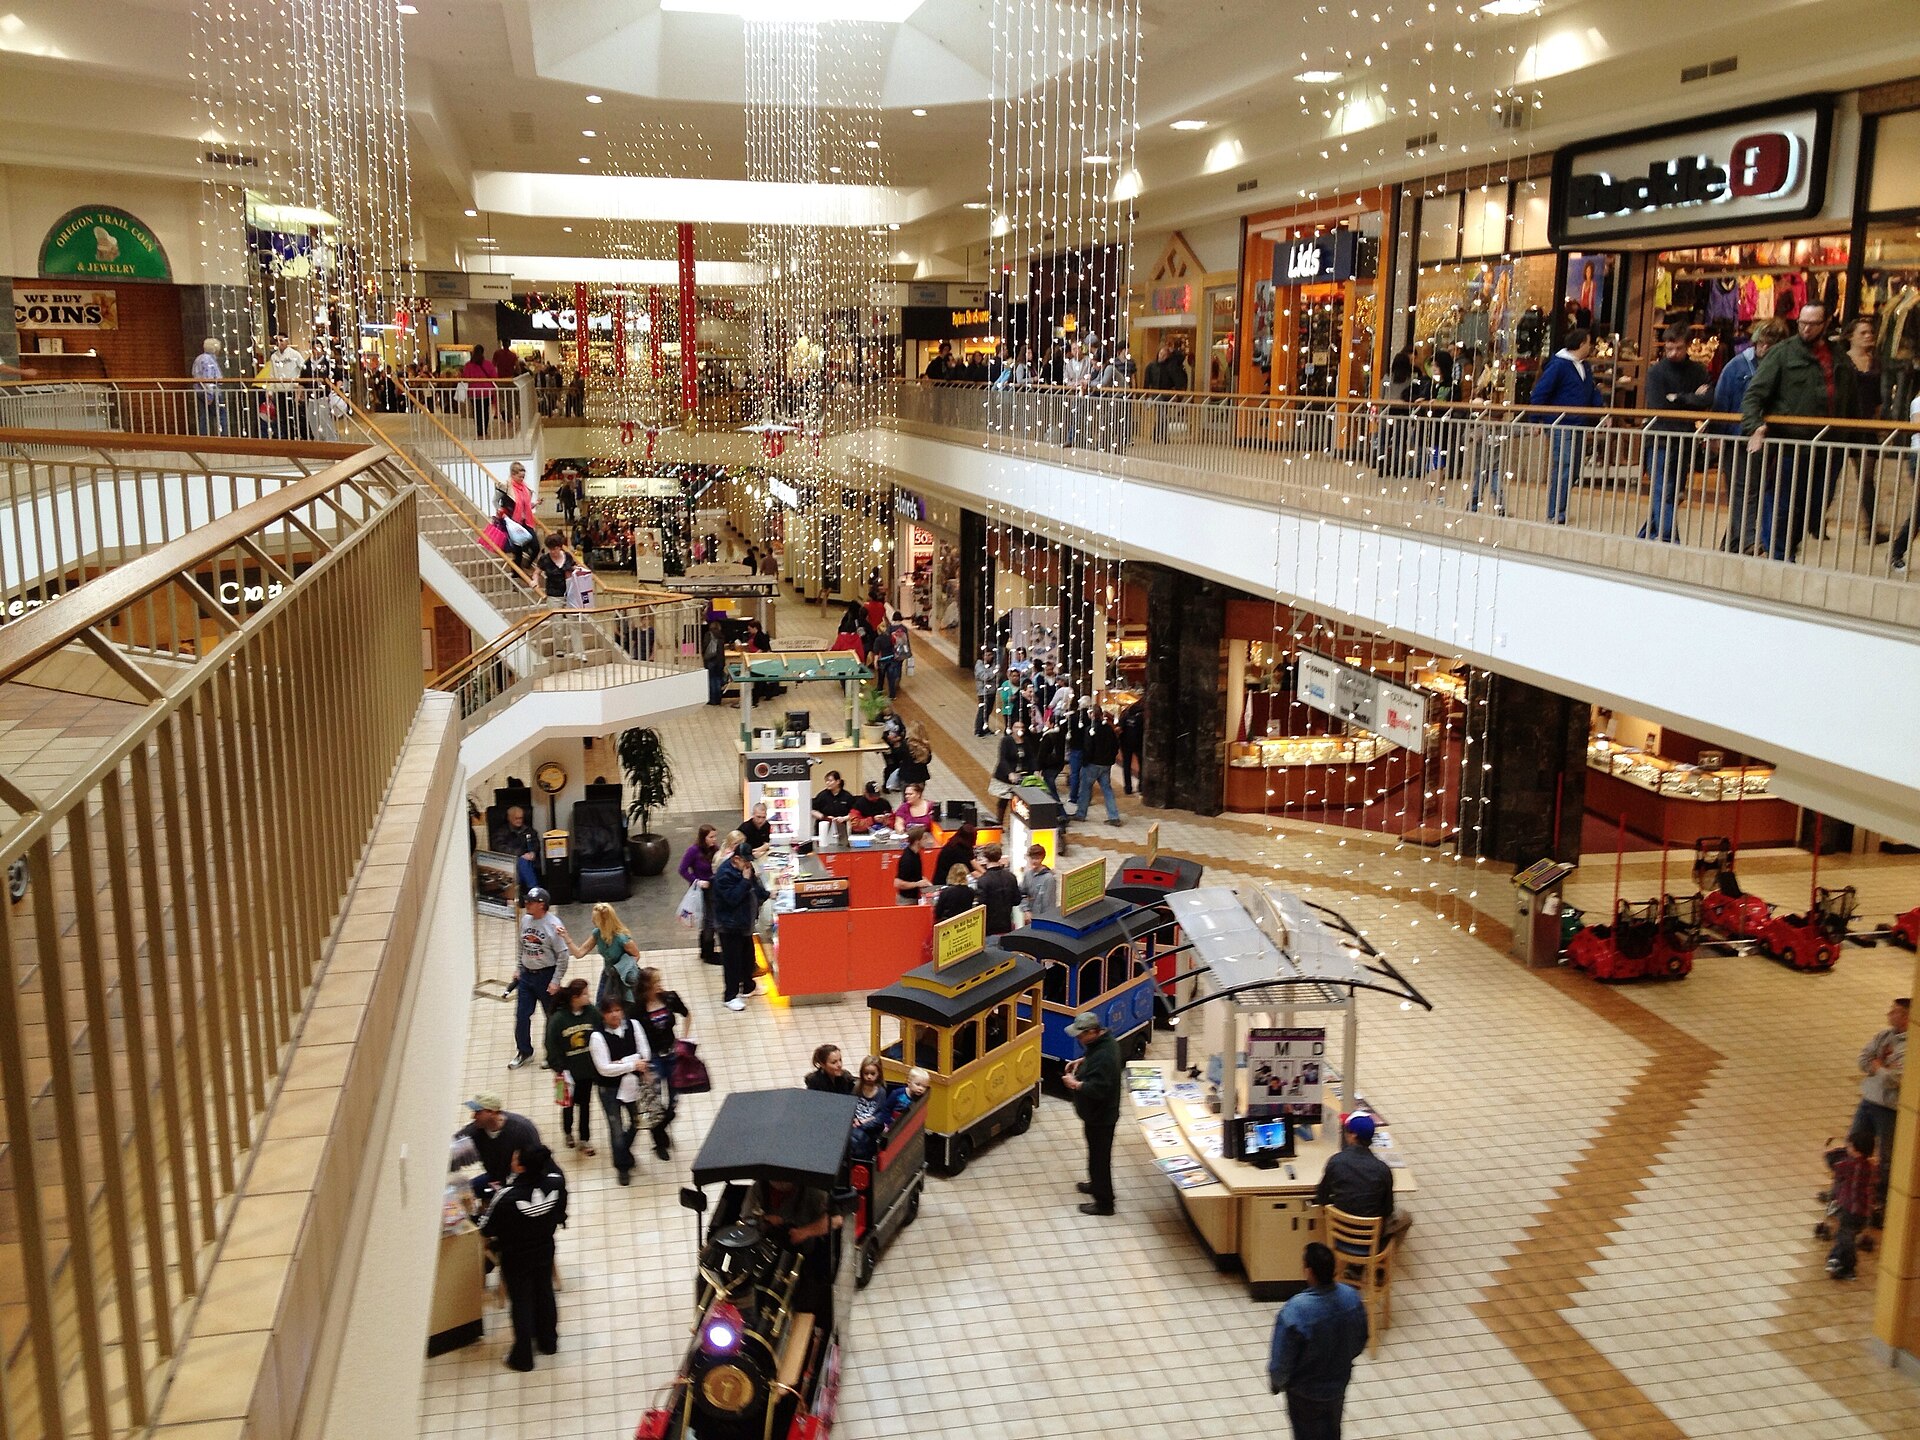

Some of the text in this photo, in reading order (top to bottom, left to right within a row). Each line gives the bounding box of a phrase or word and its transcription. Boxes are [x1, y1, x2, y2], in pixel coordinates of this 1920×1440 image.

[1569, 155, 1729, 218] Buckle
[56, 213, 154, 253] OREGON TRAIL COIN
[77, 262, 136, 274] & JEWELRY
[1288, 242, 1320, 278] Lids
[24, 294, 82, 303] WE BUY
[14, 305, 102, 324] COINS
